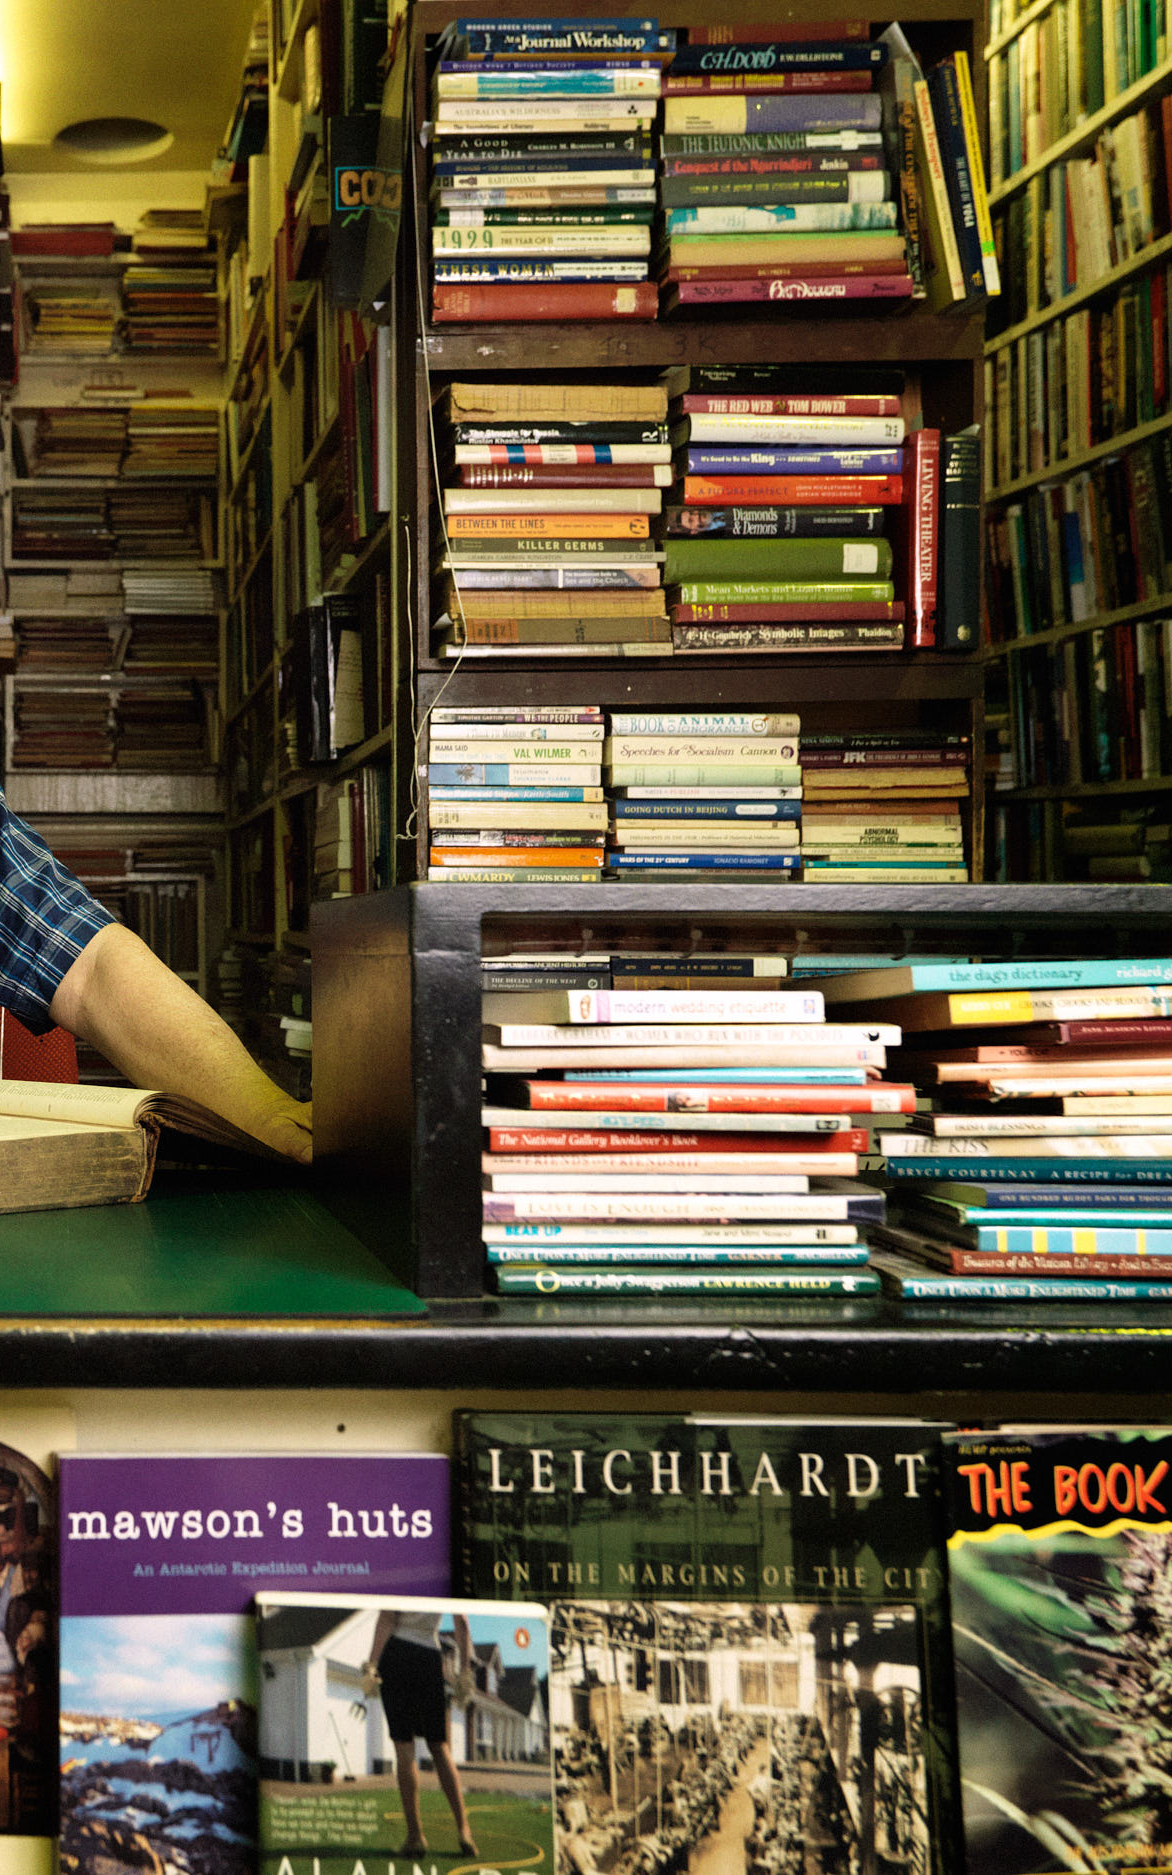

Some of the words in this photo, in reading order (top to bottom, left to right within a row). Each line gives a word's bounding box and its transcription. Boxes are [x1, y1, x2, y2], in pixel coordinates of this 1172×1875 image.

[518, 34, 572, 50] Journal
[573, 32, 646, 49] Workshop
[682, 136, 706, 154] THE
[708, 134, 763, 153] TEUTONIC
[961, 204, 976, 228] YOGA
[440, 230, 493, 249] 1929
[440, 265, 491, 277] THESE
[497, 263, 555, 277] WOMEN
[708, 400, 727, 412] THE
[730, 400, 750, 413] RED
[752, 400, 773, 412] WEB
[788, 401, 809, 413] TOM
[811, 401, 846, 413] BOWER
[750, 453, 775, 466] King
[921, 458, 934, 513] LIVING
[733, 507, 778, 522] Diamonds
[456, 519, 497, 529] BETWEEN
[501, 519, 516, 529] THE
[519, 519, 545, 529] LINES
[733, 522, 742, 535] &
[742, 520, 778, 535] Demons
[518, 541, 560, 550] KILLER
[565, 541, 604, 551] GERMS
[920, 514, 933, 583] THEATER
[706, 585, 731, 594] Mean
[733, 585, 769, 594] Markets
[772, 585, 788, 594] and
[758, 628, 805, 640] Symbolic
[809, 628, 845, 640] Images
[858, 628, 893, 638] Phaidon
[550, 713, 578, 724] PEOPLE
[630, 718, 664, 733] BOOK
[679, 717, 749, 726] ANIMAL
[455, 744, 468, 752] SAID
[513, 748, 530, 758] VAL
[534, 747, 572, 759] WILMER
[621, 745, 665, 758] Speeches
[668, 744, 681, 757] for
[685, 743, 734, 757] Socialism
[740, 744, 778, 757] Cannon
[843, 751, 866, 763] JFK
[625, 805, 650, 815] GOING
[654, 805, 680, 815] DUTCH
[683, 805, 693, 815] IN
[696, 805, 728, 815] BEIJING
[665, 856, 690, 864] CENTURY
[449, 872, 515, 883] CWMARDY
[950, 969, 971, 981] the
[974, 968, 1008, 983] dag's
[1012, 965, 1083, 981] dictionary
[1116, 965, 1162, 978] richard
[615, 1002, 666, 1014] modern
[671, 1001, 725, 1016] wedding
[729, 1000, 786, 1017] etiquette
[498, 1134, 518, 1146] The
[523, 1134, 566, 1146] National
[569, 1135, 607, 1148] Gallery
[610, 1134, 669, 1146] Booklover's
[672, 1134, 698, 1146] Book
[903, 1139, 938, 1153] THE
[949, 1139, 989, 1153] KISS
[898, 1167, 940, 1177] BRYCE
[948, 1168, 1036, 1179] COURTENAY
[1050, 1171, 1060, 1179] A
[1065, 1171, 1109, 1180] RECIPE
[505, 1226, 539, 1236] BEAR
[544, 1226, 562, 1237] UP
[488, 1448, 927, 1498] LEICHHARDT
[957, 1460, 1033, 1518] THE
[1054, 1460, 1170, 1516] BOOK
[68, 1502, 305, 1541] mawson's
[327, 1502, 434, 1539] huts
[133, 1562, 155, 1577] An
[160, 1561, 227, 1577] Antarctic
[232, 1561, 308, 1578] Expedition
[312, 1560, 370, 1576] Journal
[493, 1562, 531, 1583] ON
[548, 1563, 602, 1585] THE
[617, 1564, 746, 1587] MARGINS
[761, 1567, 796, 1588] OF
[813, 1566, 866, 1588] THE
